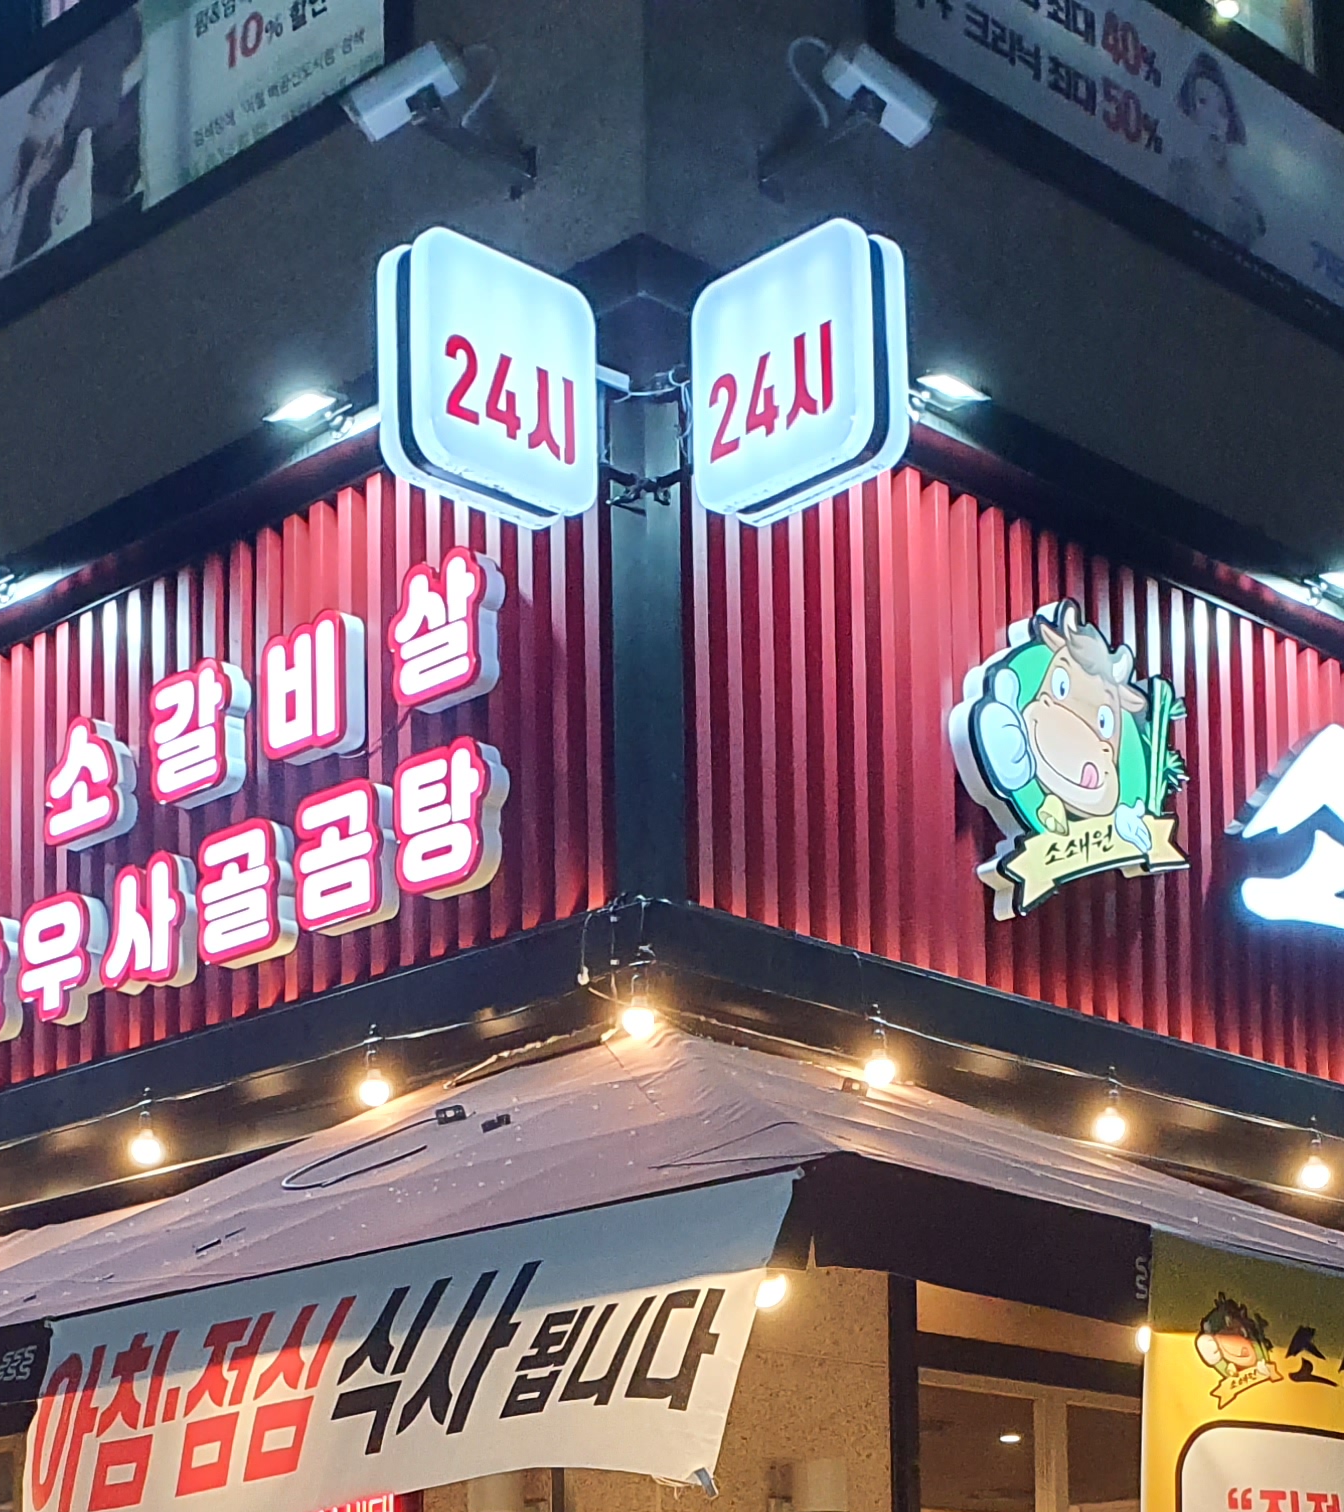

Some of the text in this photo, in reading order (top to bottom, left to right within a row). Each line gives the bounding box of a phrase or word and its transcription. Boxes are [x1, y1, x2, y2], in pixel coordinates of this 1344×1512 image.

[225, 10, 283, 69] 10%
[1102, 10, 1162, 88] 40%
[1102, 76, 1163, 154] 50%
[444, 333, 577, 467] 24시
[708, 320, 834, 465] 24시
[45, 545, 484, 850] 소갈비살
[1042, 823, 1116, 867] 소쇄원
[329, 1259, 543, 1456] 식사
[499, 1287, 725, 1421] 됩니다
